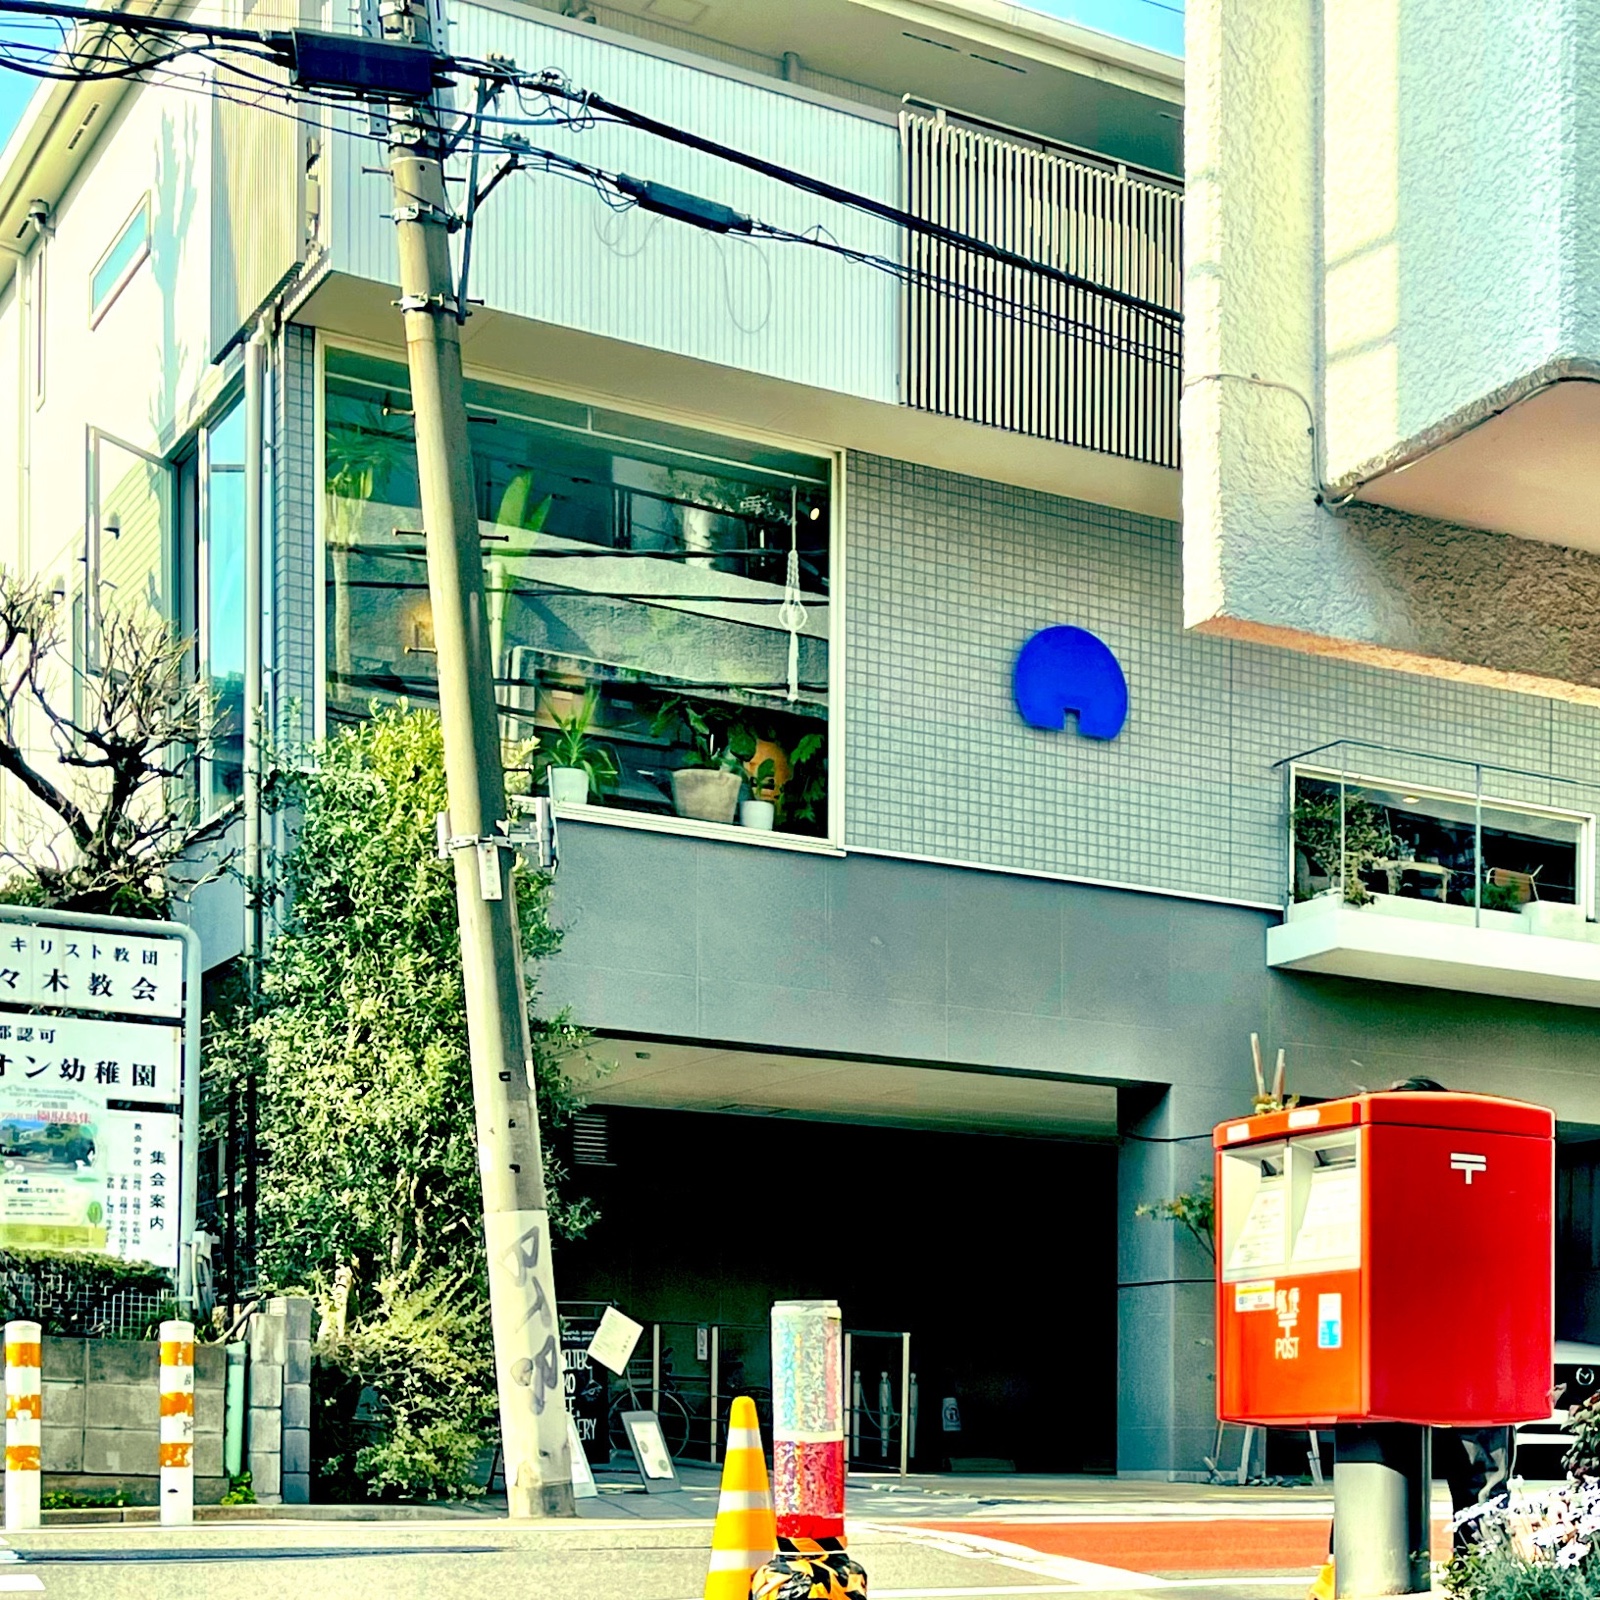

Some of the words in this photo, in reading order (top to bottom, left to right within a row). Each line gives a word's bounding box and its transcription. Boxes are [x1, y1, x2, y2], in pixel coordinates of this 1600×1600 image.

[10, 937, 159, 966] キリスト教団
[0, 968, 158, 1002] 々木教会
[150, 1150, 166, 1231] 集会案内
[1275, 1337, 1299, 1359] POST
